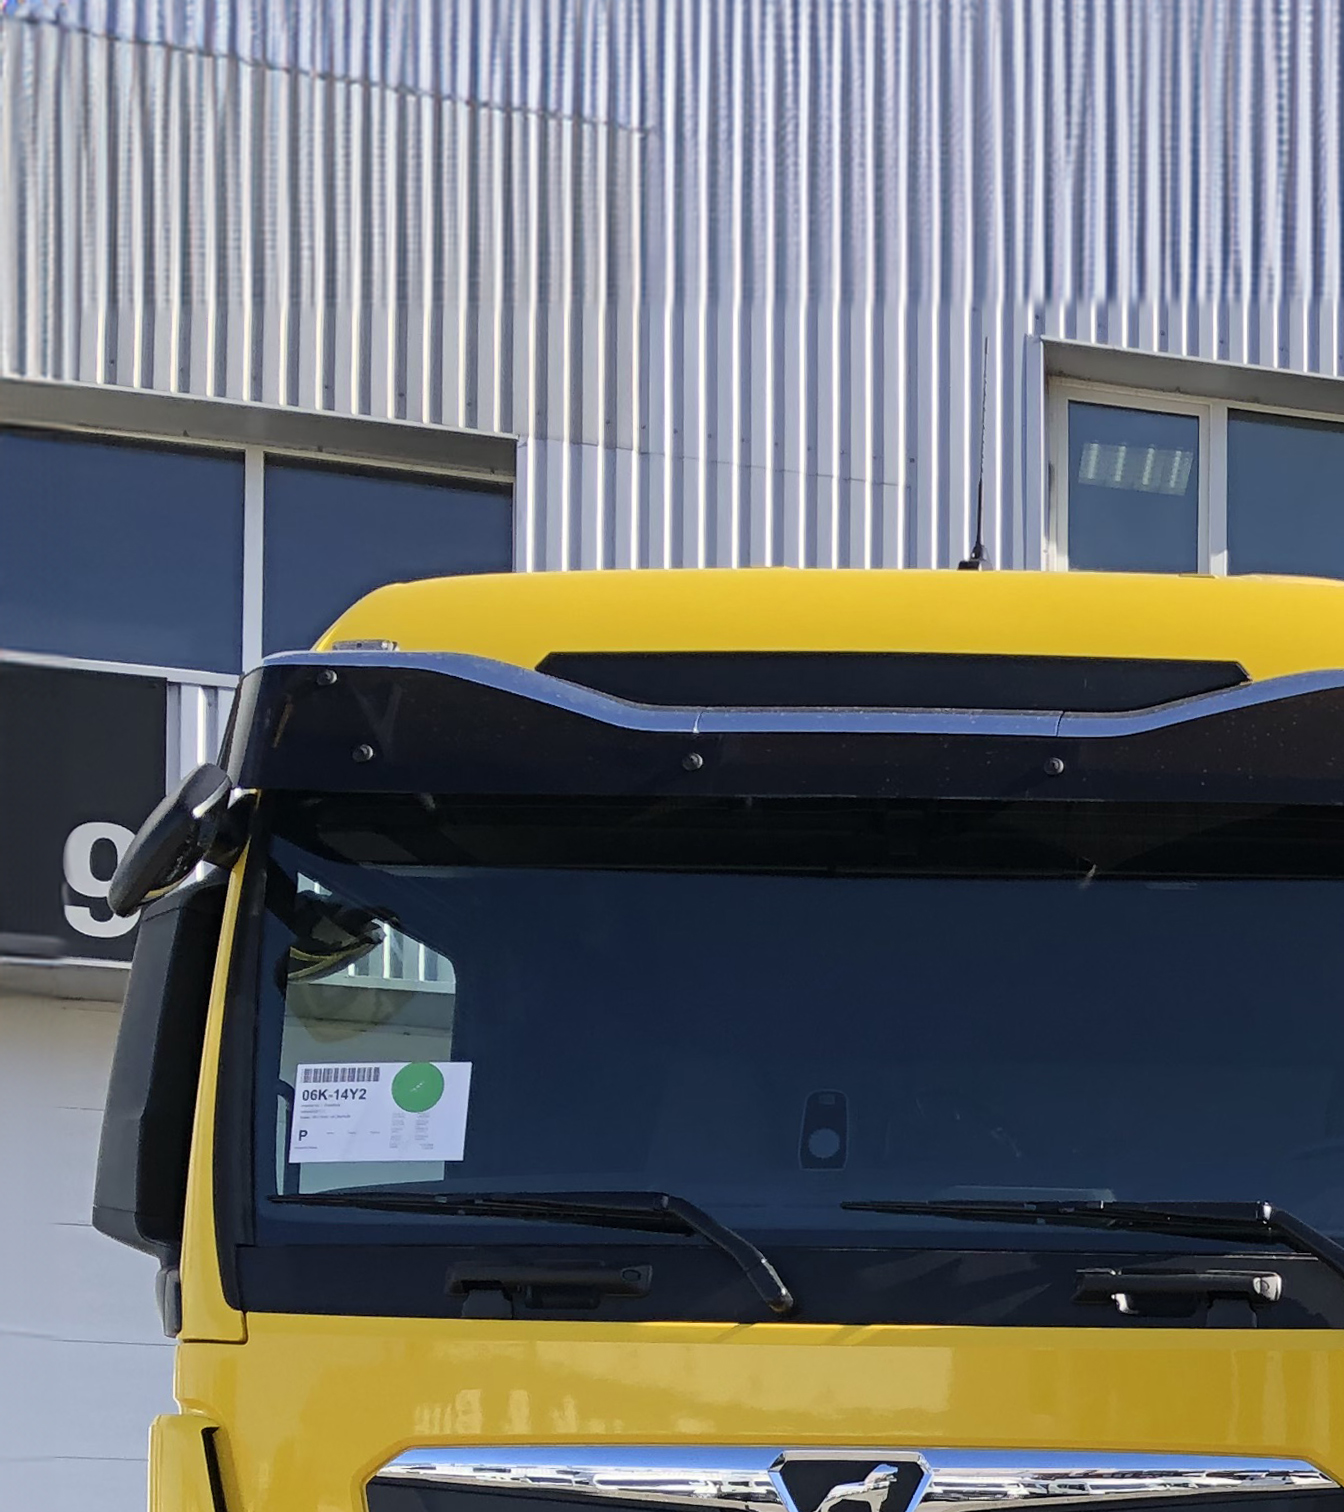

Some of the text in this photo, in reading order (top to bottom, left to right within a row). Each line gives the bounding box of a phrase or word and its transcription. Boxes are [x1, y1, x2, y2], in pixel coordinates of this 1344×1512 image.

[62, 821, 142, 938] 9
[302, 1088, 366, 1101] 06K-14Y2
[298, 1129, 308, 1141] P
